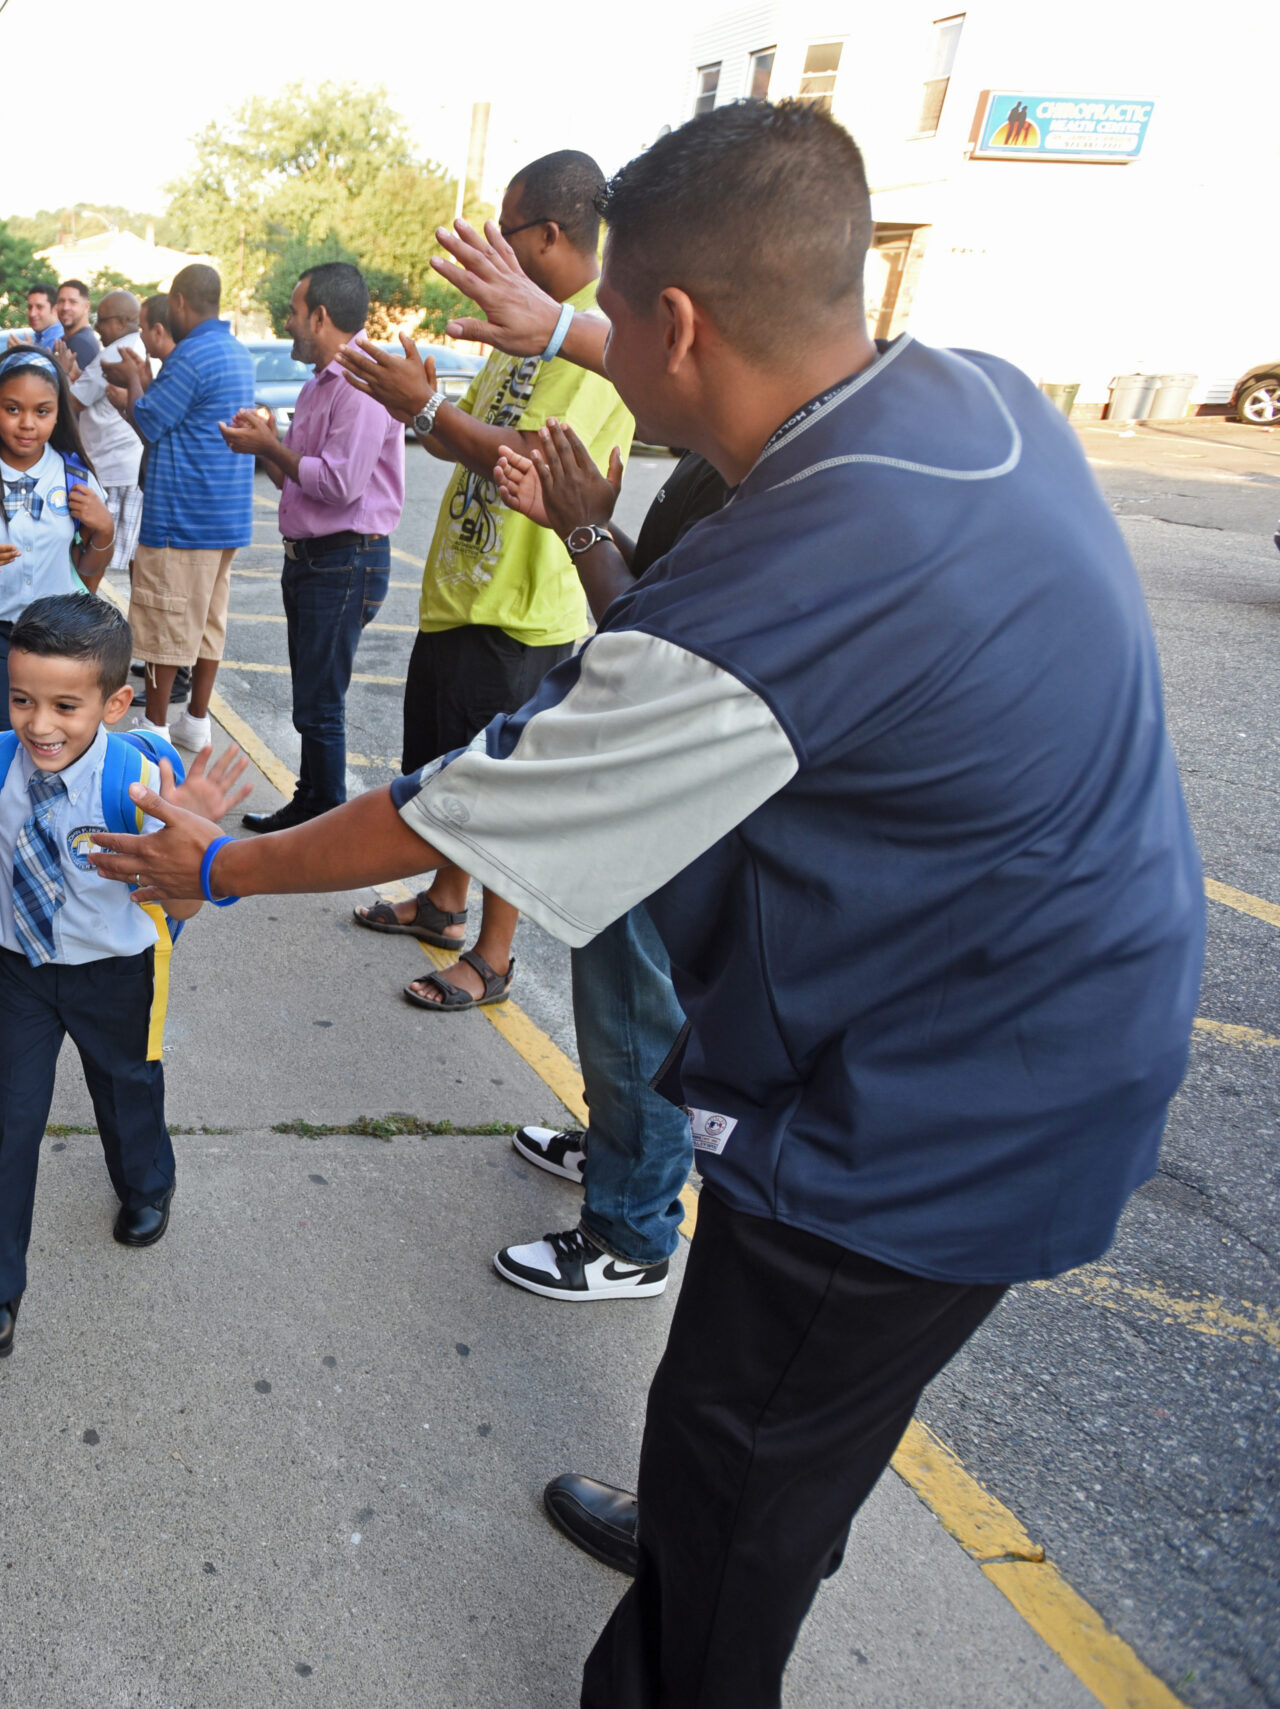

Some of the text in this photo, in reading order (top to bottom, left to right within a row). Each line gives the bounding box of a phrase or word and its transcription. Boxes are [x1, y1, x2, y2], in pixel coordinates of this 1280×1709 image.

[1036, 102, 1152, 122] CHIROPRACTIC
[1049, 119, 1142, 134] HEALTH CENTER
